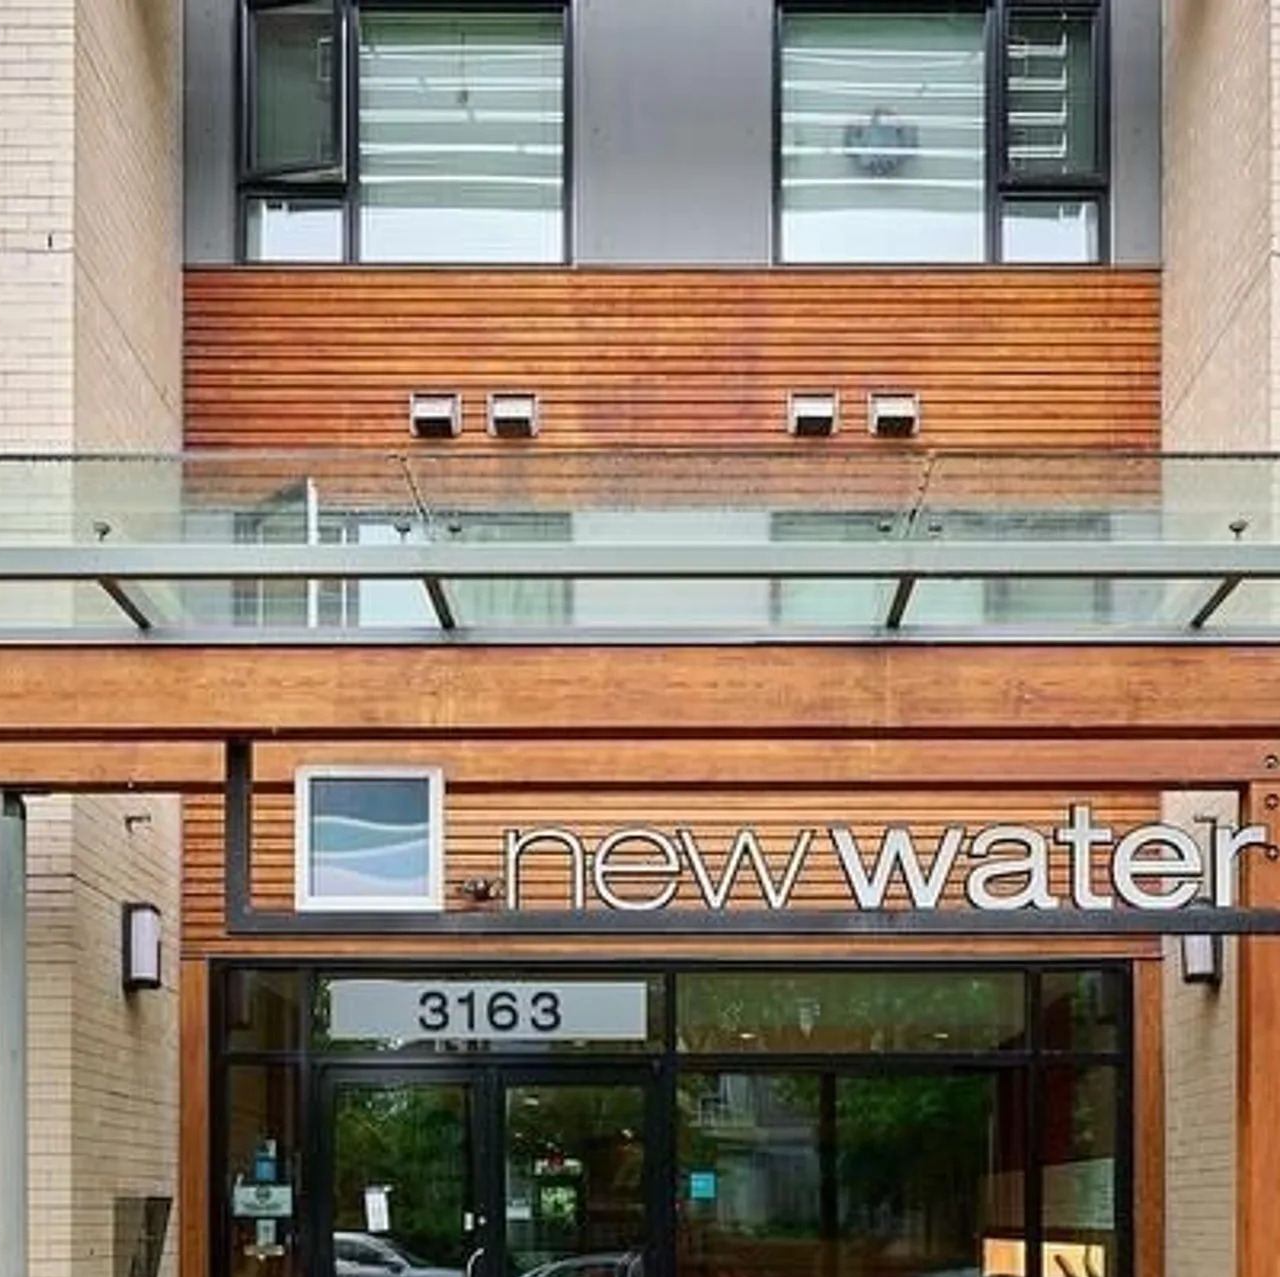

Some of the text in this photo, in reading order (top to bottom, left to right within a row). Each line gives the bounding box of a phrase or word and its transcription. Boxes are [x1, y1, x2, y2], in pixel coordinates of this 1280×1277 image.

[504, 802, 1267, 911] new water
[418, 989, 563, 1032] 3163
